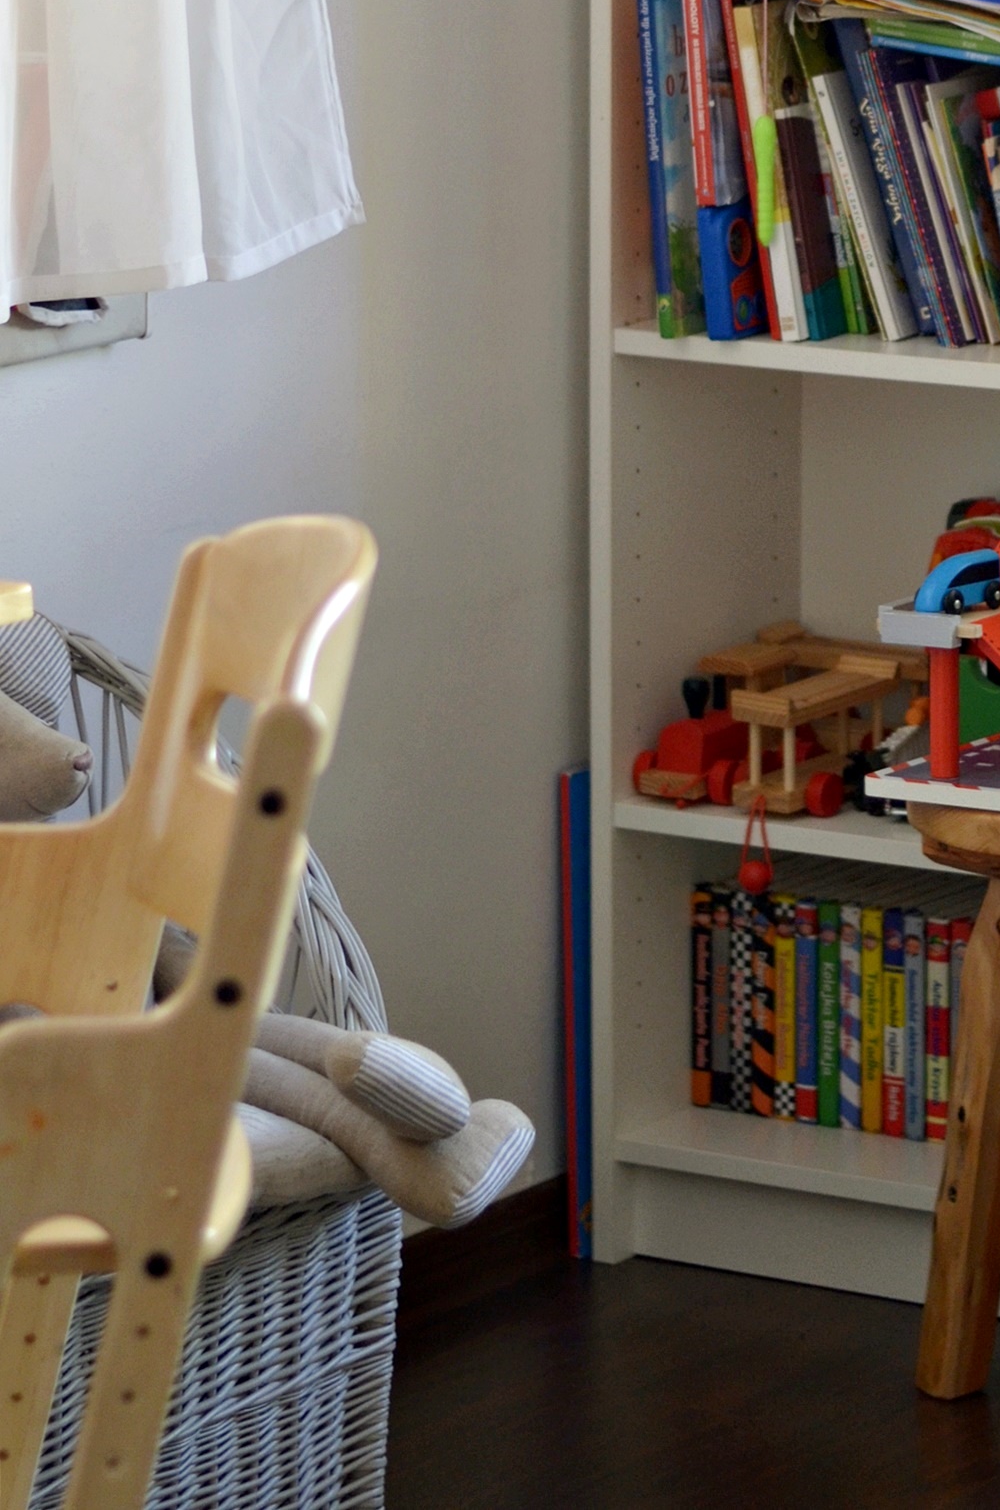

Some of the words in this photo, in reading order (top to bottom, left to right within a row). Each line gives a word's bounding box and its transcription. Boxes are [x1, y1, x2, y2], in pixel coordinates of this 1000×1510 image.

[640, 17, 650, 30] dla
[821, 962, 836, 1015] Kolejka
[867, 973, 878, 1030] Traktor
[820, 1019, 836, 1076] Błażeja
[887, 1031, 900, 1074] rajdowy
